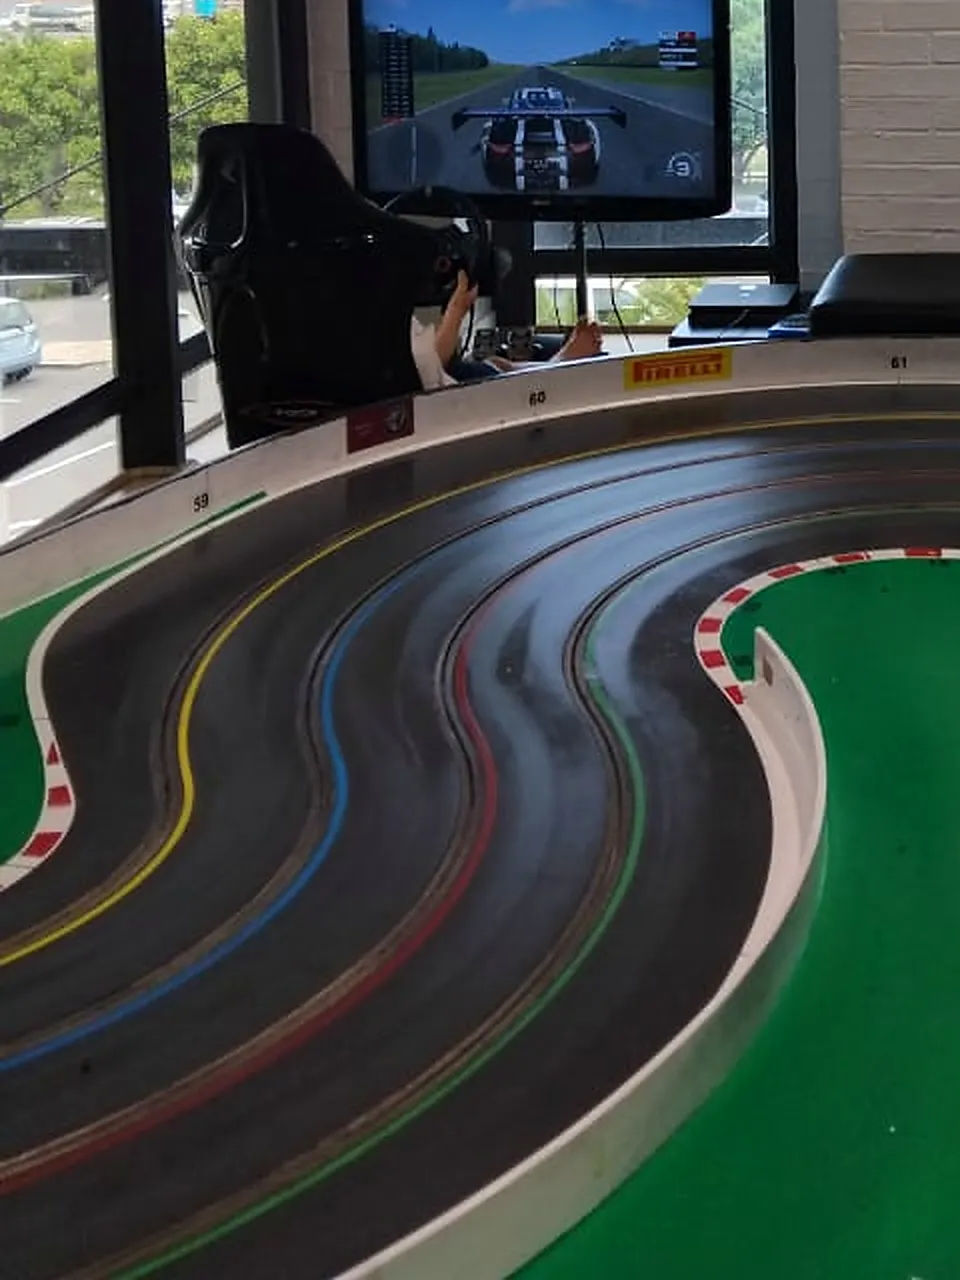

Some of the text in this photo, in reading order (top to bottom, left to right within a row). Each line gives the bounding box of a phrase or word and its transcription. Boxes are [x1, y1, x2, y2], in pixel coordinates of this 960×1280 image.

[676, 161, 690, 176] 3
[633, 352, 723, 383] PIRELLI
[891, 356, 907, 369] 61
[529, 391, 546, 407] 60
[193, 493, 209, 512] 59
